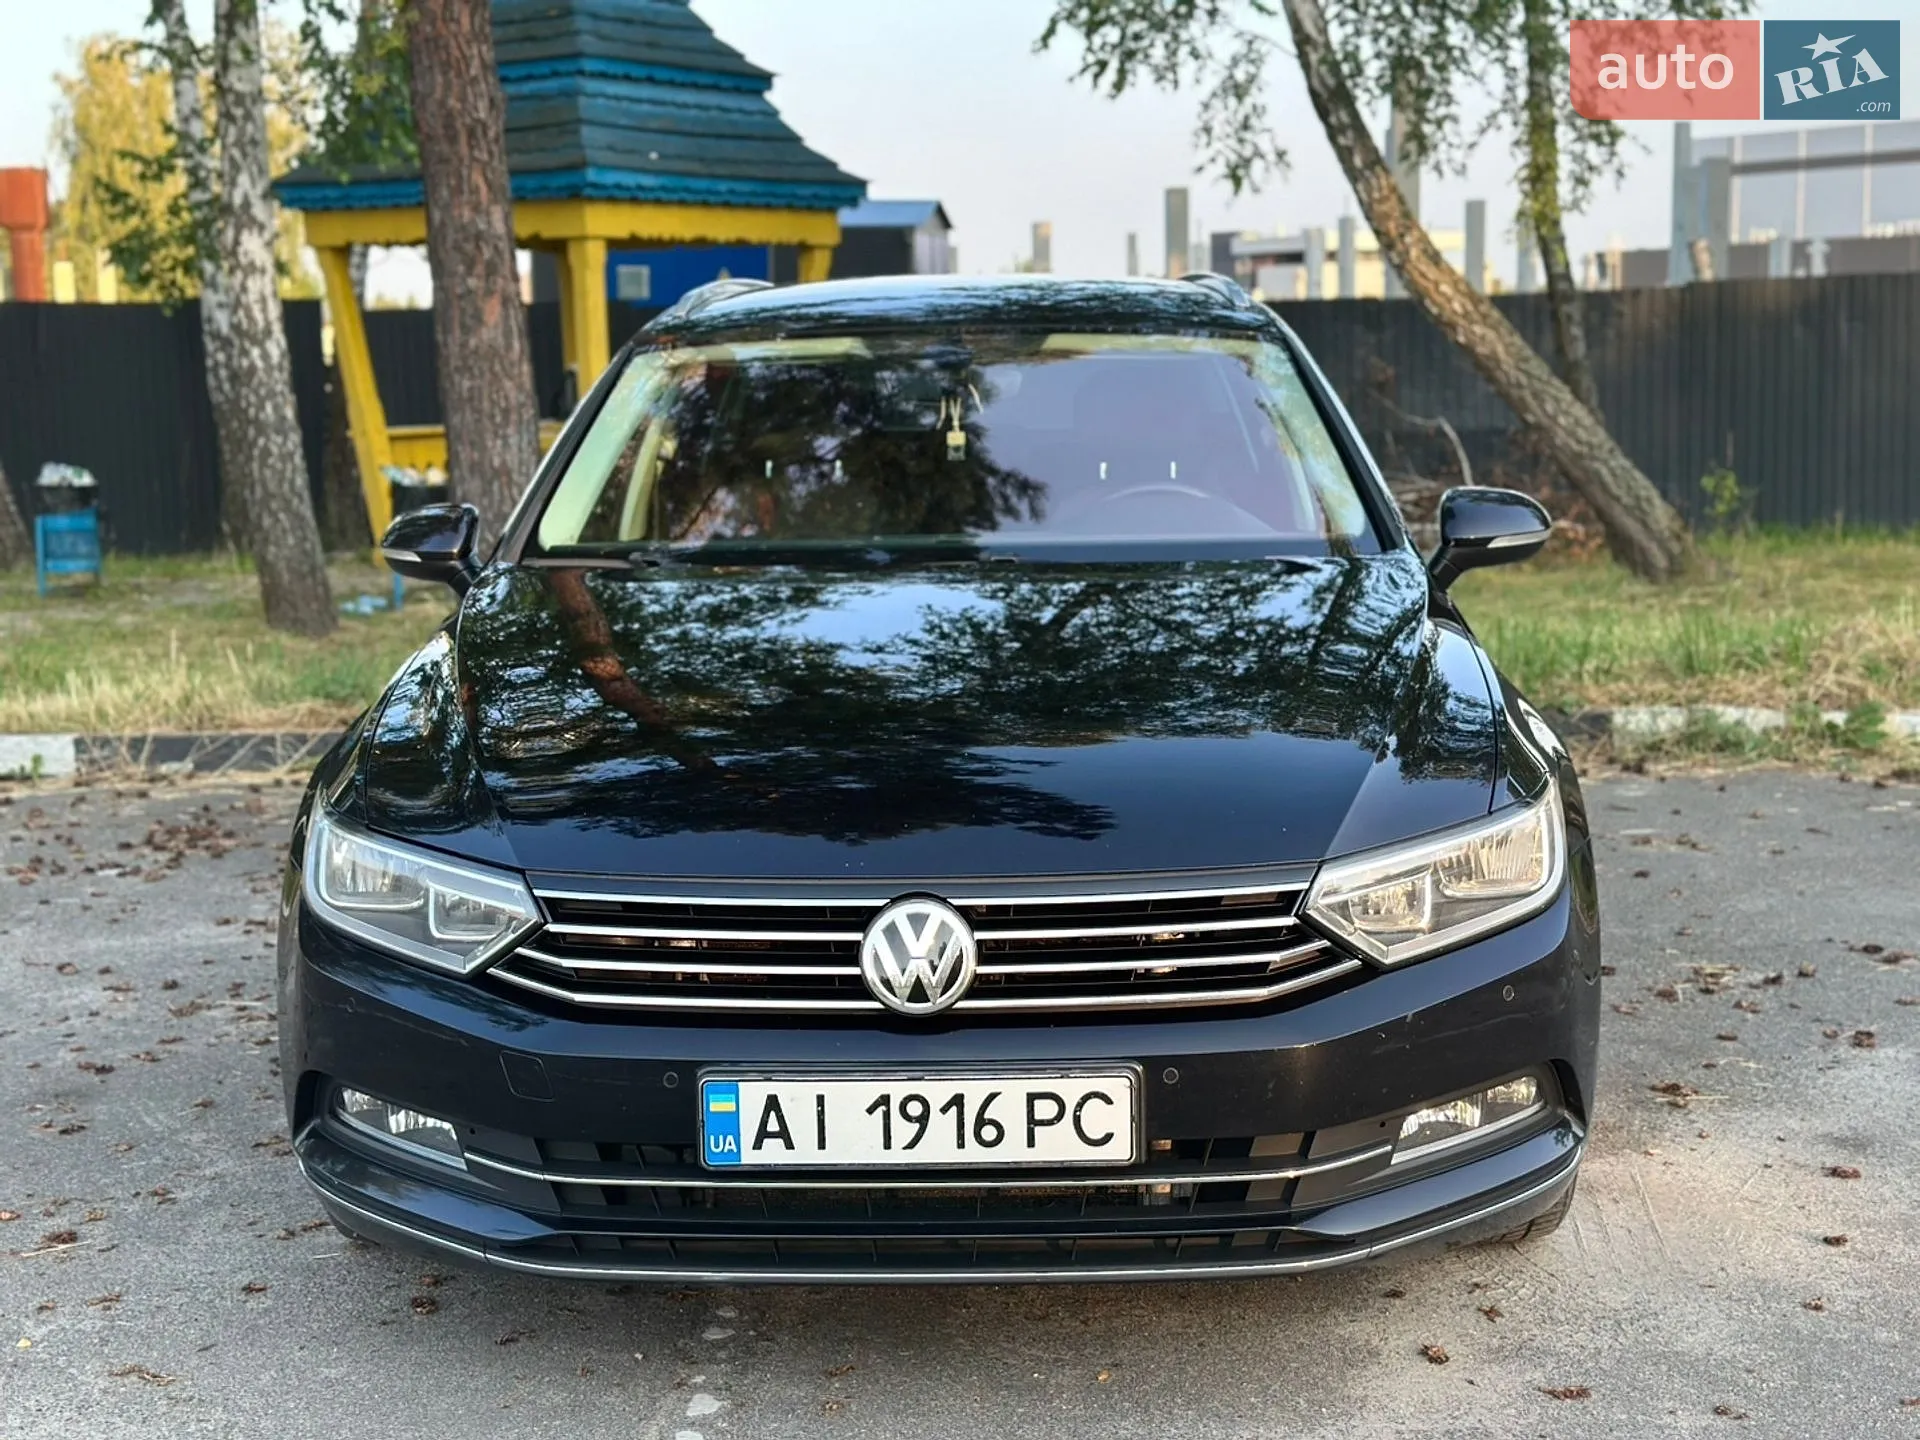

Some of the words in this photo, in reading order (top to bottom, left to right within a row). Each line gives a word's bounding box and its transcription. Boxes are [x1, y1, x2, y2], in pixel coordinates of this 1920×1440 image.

[751, 1093, 826, 1150] AI
[864, 1091, 1006, 1150] 1916
[1025, 1091, 1115, 1148] PC
[709, 1134, 738, 1153] UA
